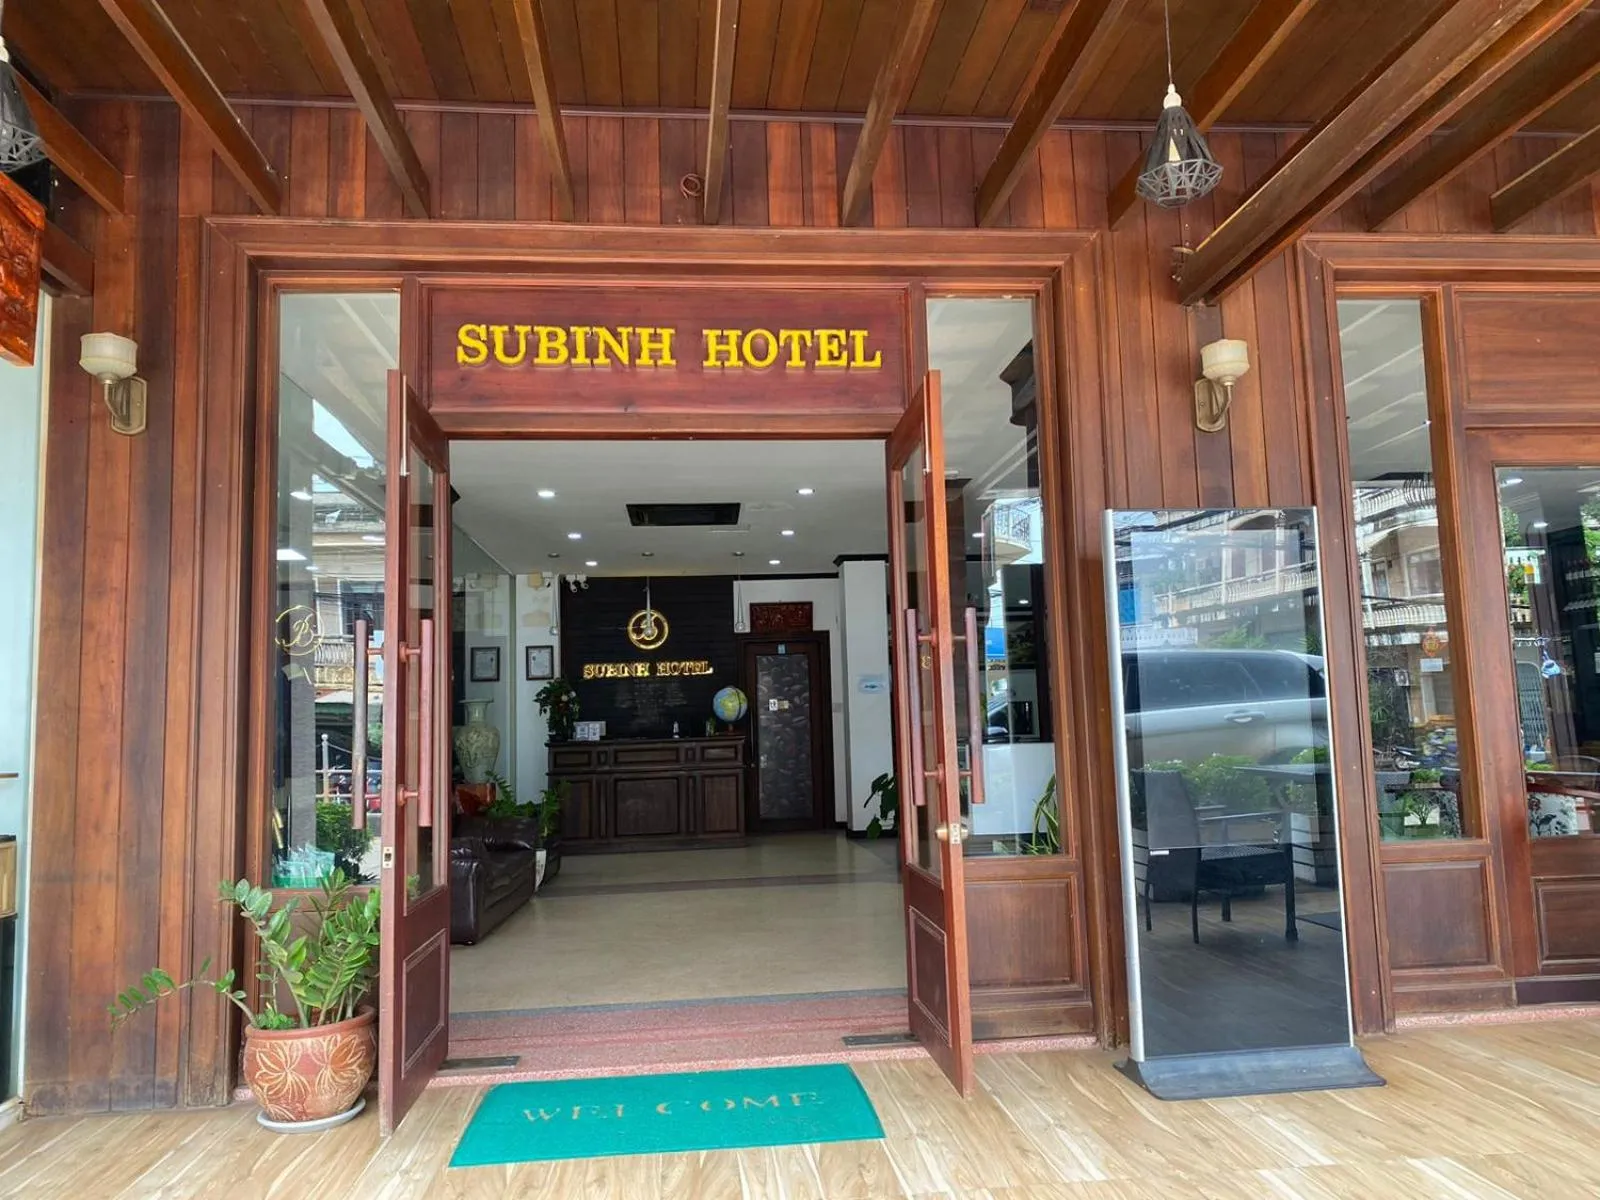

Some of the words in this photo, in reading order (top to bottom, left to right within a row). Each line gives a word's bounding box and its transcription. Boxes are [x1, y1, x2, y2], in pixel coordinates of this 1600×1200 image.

[456, 323, 677, 368] SUBINH
[702, 328, 882, 369] HOTEL
[582, 662, 650, 679] SUBINH
[656, 660, 714, 677] HOTEL
